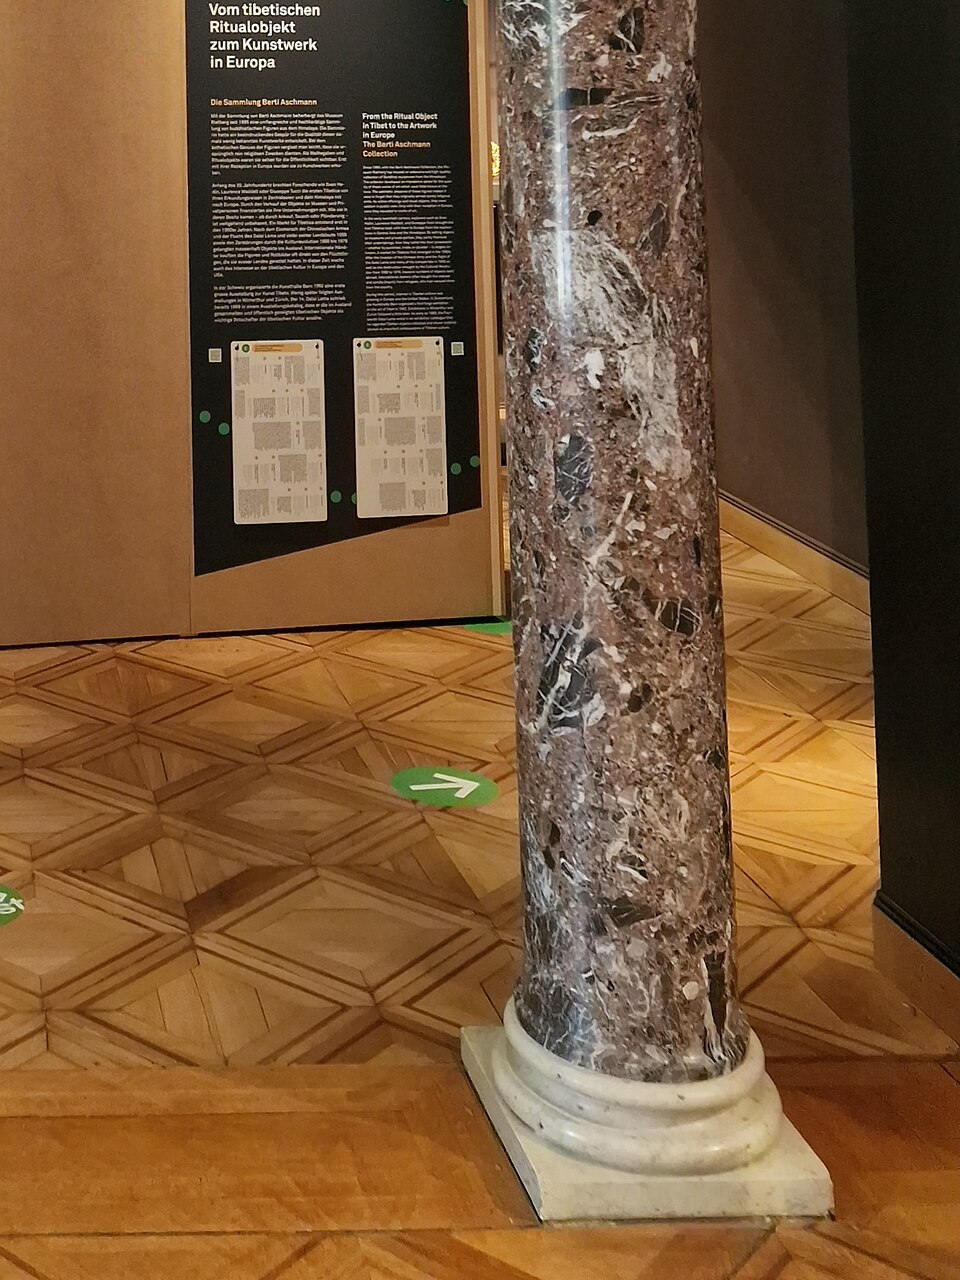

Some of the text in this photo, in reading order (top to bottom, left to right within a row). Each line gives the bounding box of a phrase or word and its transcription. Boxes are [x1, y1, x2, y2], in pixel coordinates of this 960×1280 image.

[209, 2, 321, 17] Vom tibetischen
[209, 20, 296, 36] Ritualobjekt
[210, 38, 318, 52] zum Kunstwerk
[210, 56, 276, 71] in Europa
[223, 99, 262, 108] Sammlung
[415, 113, 438, 121] Object
[370, 132, 395, 140] Europe
